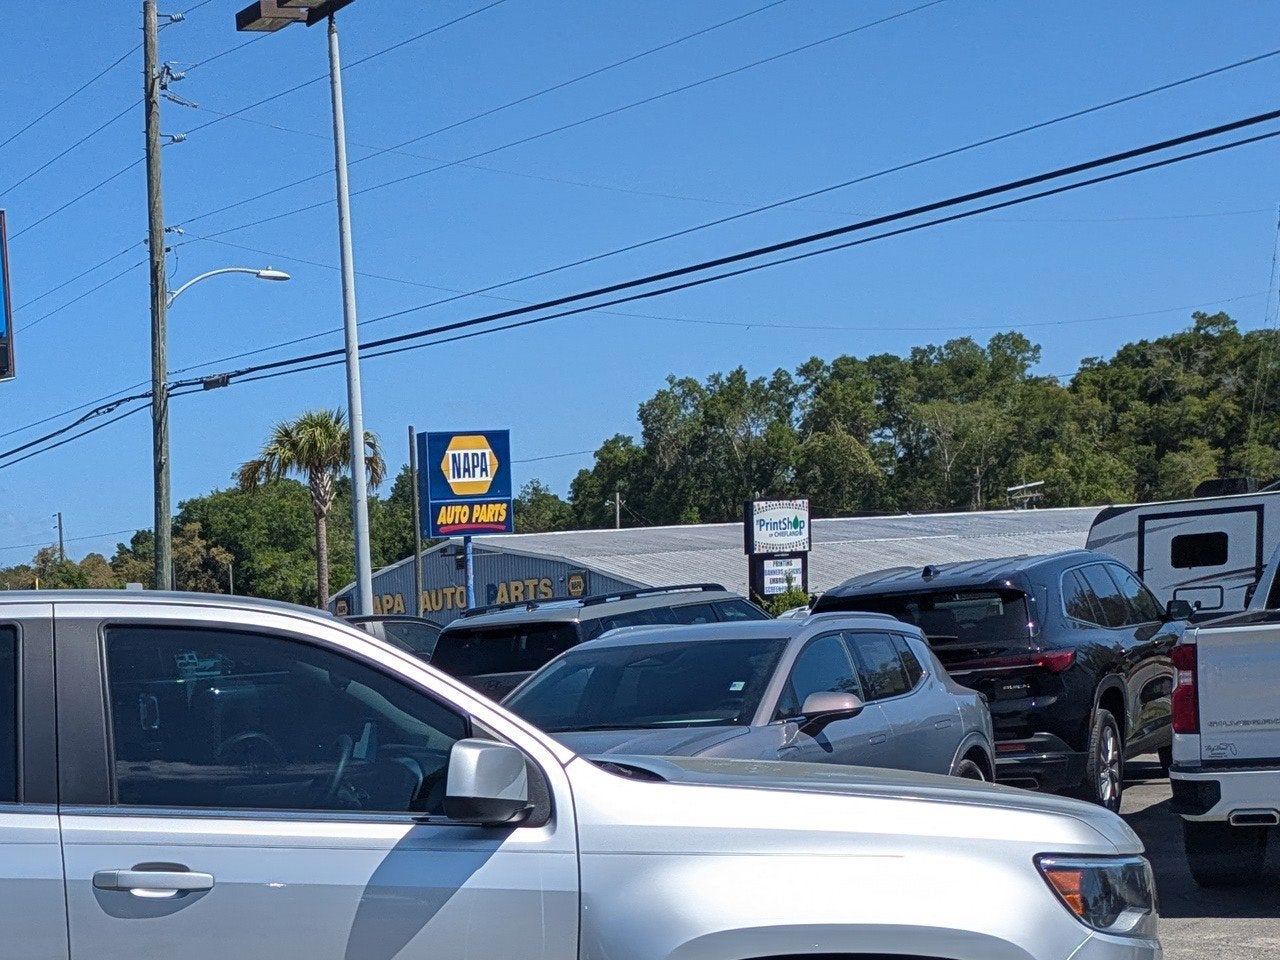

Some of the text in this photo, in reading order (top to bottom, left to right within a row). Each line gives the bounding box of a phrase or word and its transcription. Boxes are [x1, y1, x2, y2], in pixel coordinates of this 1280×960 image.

[451, 452, 489, 479] NAPA
[437, 503, 507, 525] AUTO PARTS
[373, 593, 406, 614] APA
[421, 585, 467, 613] AUTO
